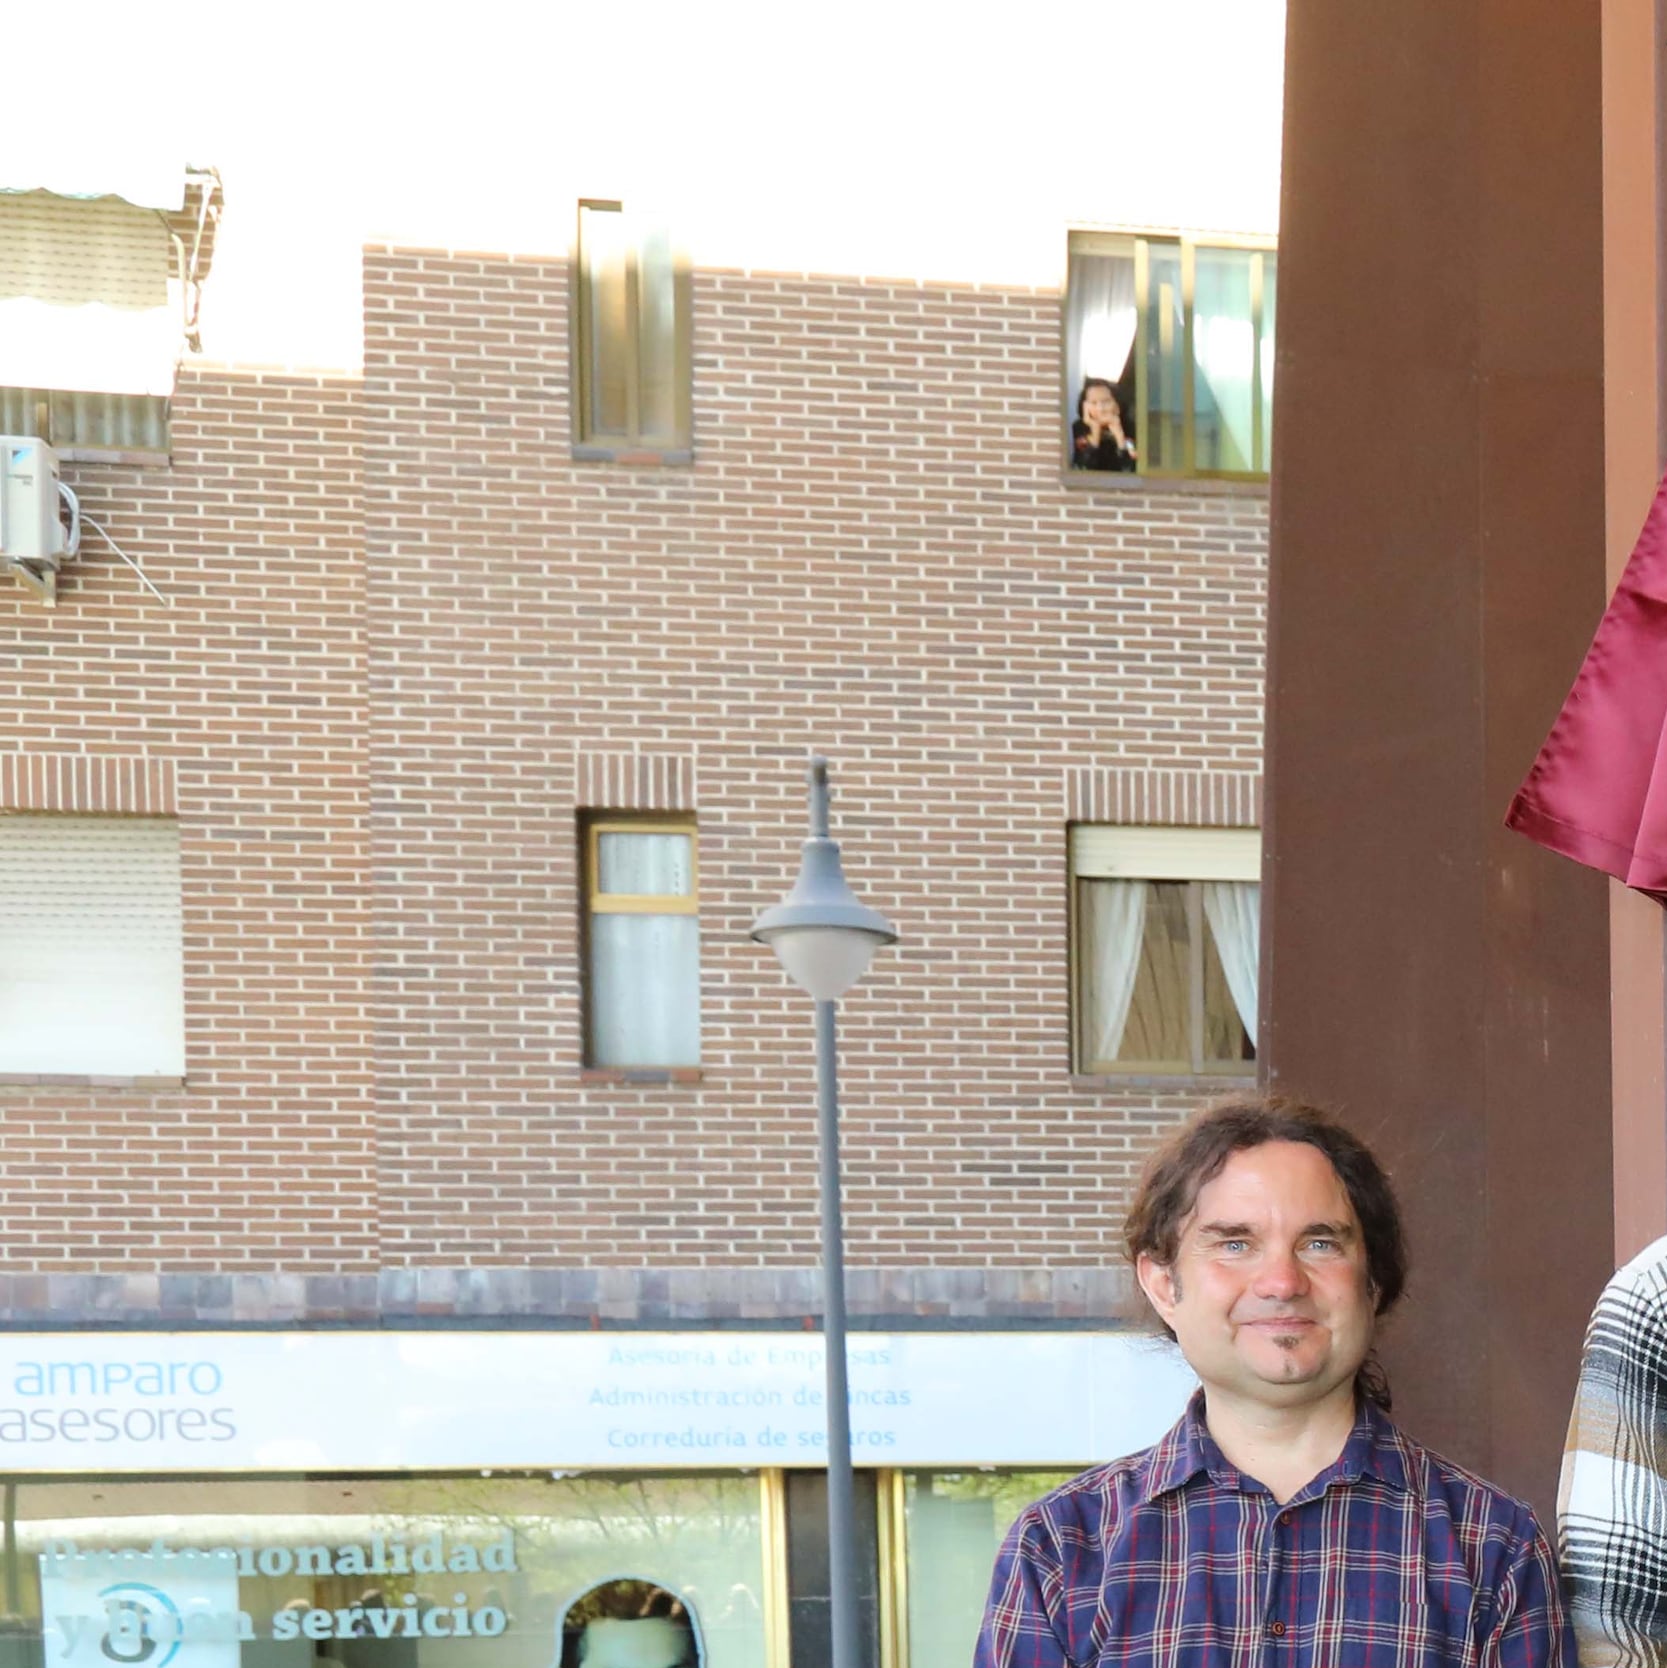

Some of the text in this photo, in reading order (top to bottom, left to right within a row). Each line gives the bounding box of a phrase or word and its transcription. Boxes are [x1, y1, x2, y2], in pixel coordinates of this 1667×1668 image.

[14, 1361, 223, 1396] amparo
[793, 1385, 823, 1406] de
[0, 1407, 237, 1442] asesores
[607, 1426, 747, 1448] Correduría
[757, 1426, 788, 1448] de
[273, 1593, 507, 1639] servicio
